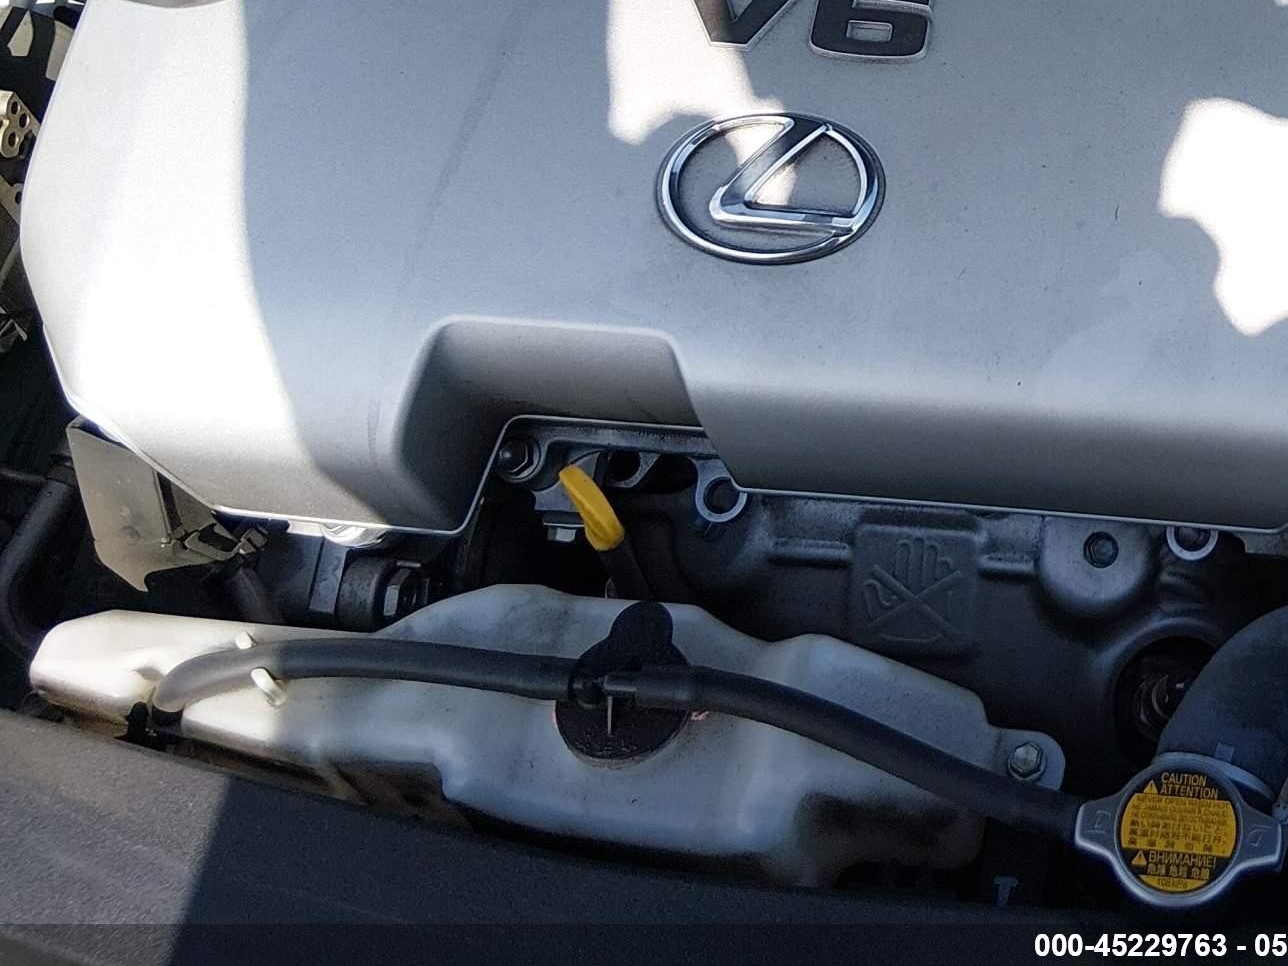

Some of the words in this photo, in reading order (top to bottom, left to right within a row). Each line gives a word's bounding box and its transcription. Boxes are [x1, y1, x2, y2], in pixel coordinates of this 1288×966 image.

[1161, 772, 1207, 786] CAUTION
[1160, 784, 1218, 799] ATTENTION
[1136, 795, 1162, 804] NEVER
[1164, 797, 1186, 806] OPEN
[1187, 799, 1211, 808] WHEN
[1148, 851, 1217, 869] ВНИМАНИЕ!
